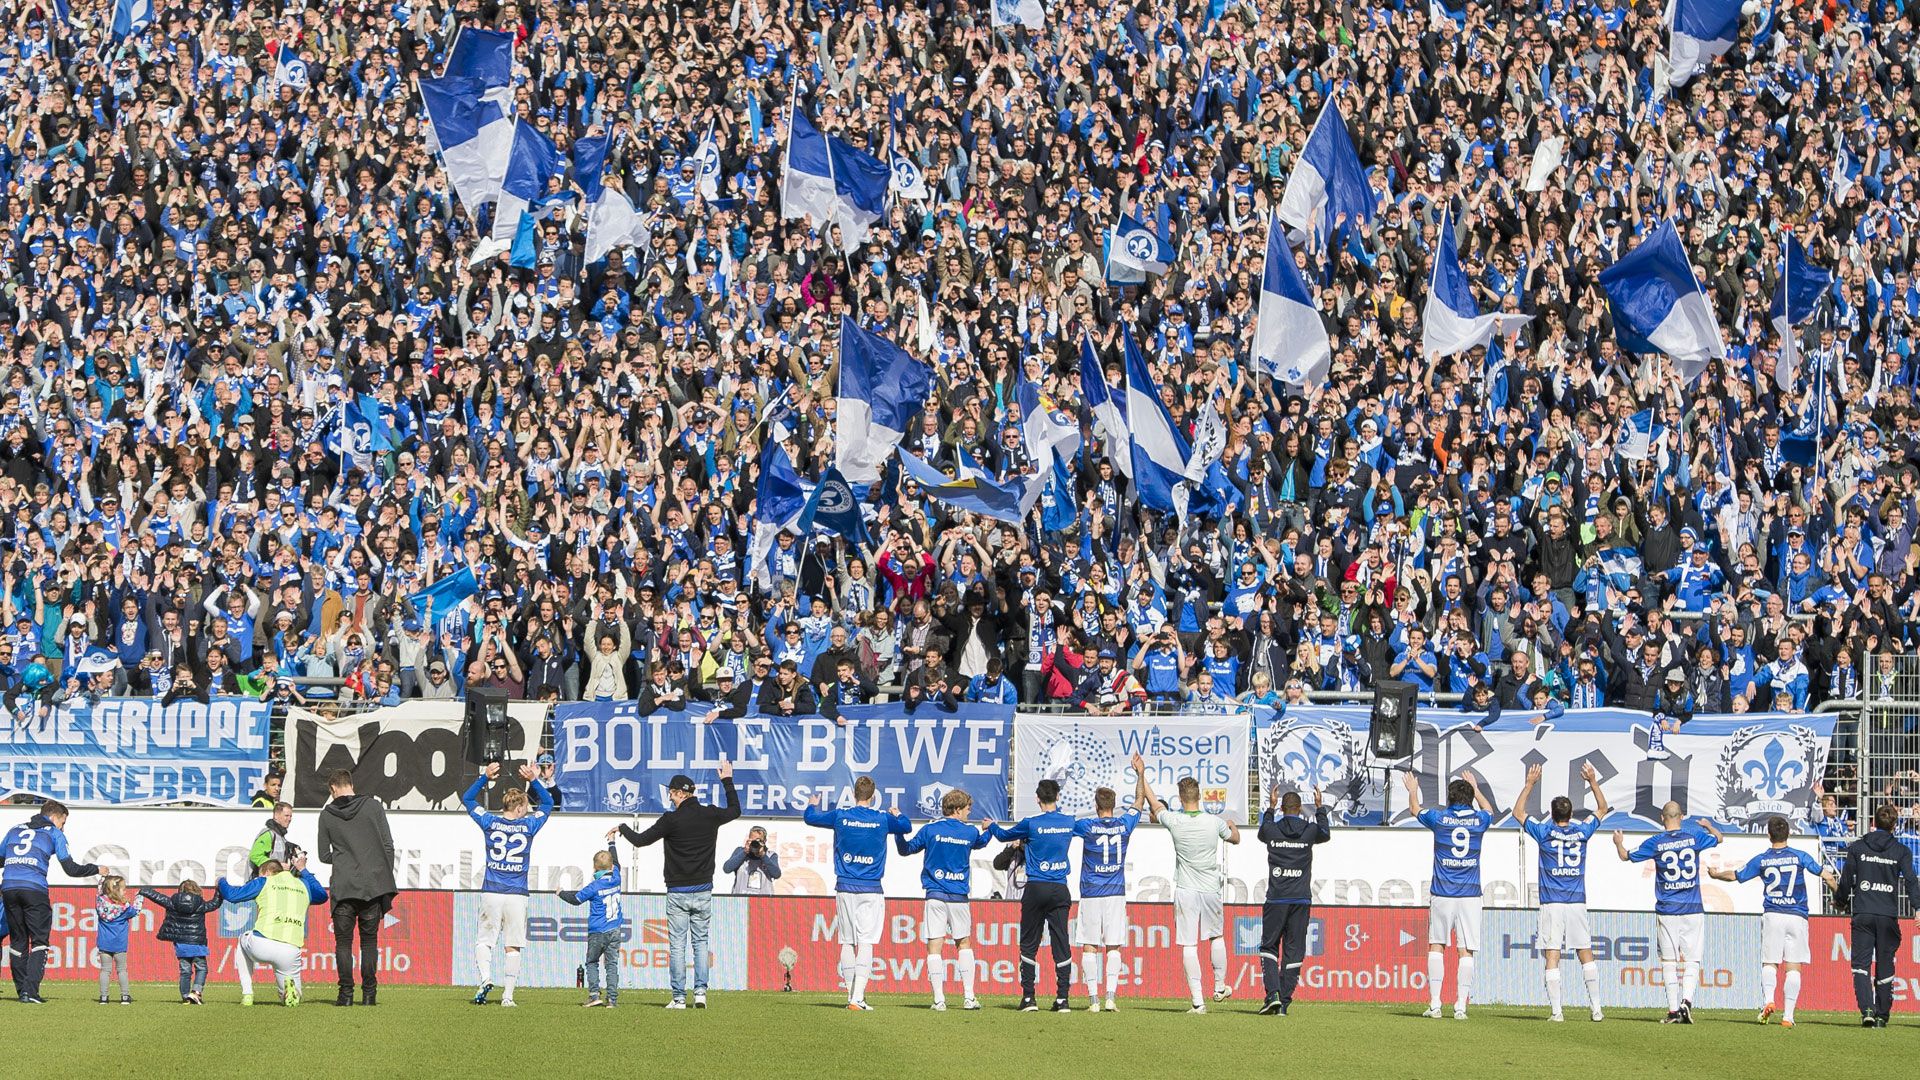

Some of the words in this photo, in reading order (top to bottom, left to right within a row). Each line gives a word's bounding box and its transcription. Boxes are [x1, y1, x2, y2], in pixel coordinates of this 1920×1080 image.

[91, 699, 267, 753] GRUPPE
[1118, 724, 1231, 756] Wissen
[562, 706, 771, 772] BÖLLE
[797, 719, 1004, 775] BUWE
[13, 829, 37, 856] 3
[489, 830, 528, 864] 32
[1095, 834, 1122, 865] 11
[1275, 841, 1304, 849] software
[1450, 826, 1470, 858] 9
[1550, 839, 1582, 868] 13
[852, 856, 874, 865] JAKO
[1049, 861, 1067, 871] JAKO
[1282, 869, 1303, 877] JAKO
[1551, 867, 1581, 876] GARICS
[1660, 847, 1697, 881] 33
[944, 872, 964, 881] JAKO
[1764, 864, 1798, 898] 27
[1871, 883, 1894, 893] JAKO
[1233, 963, 1428, 991] /HGmobilo
